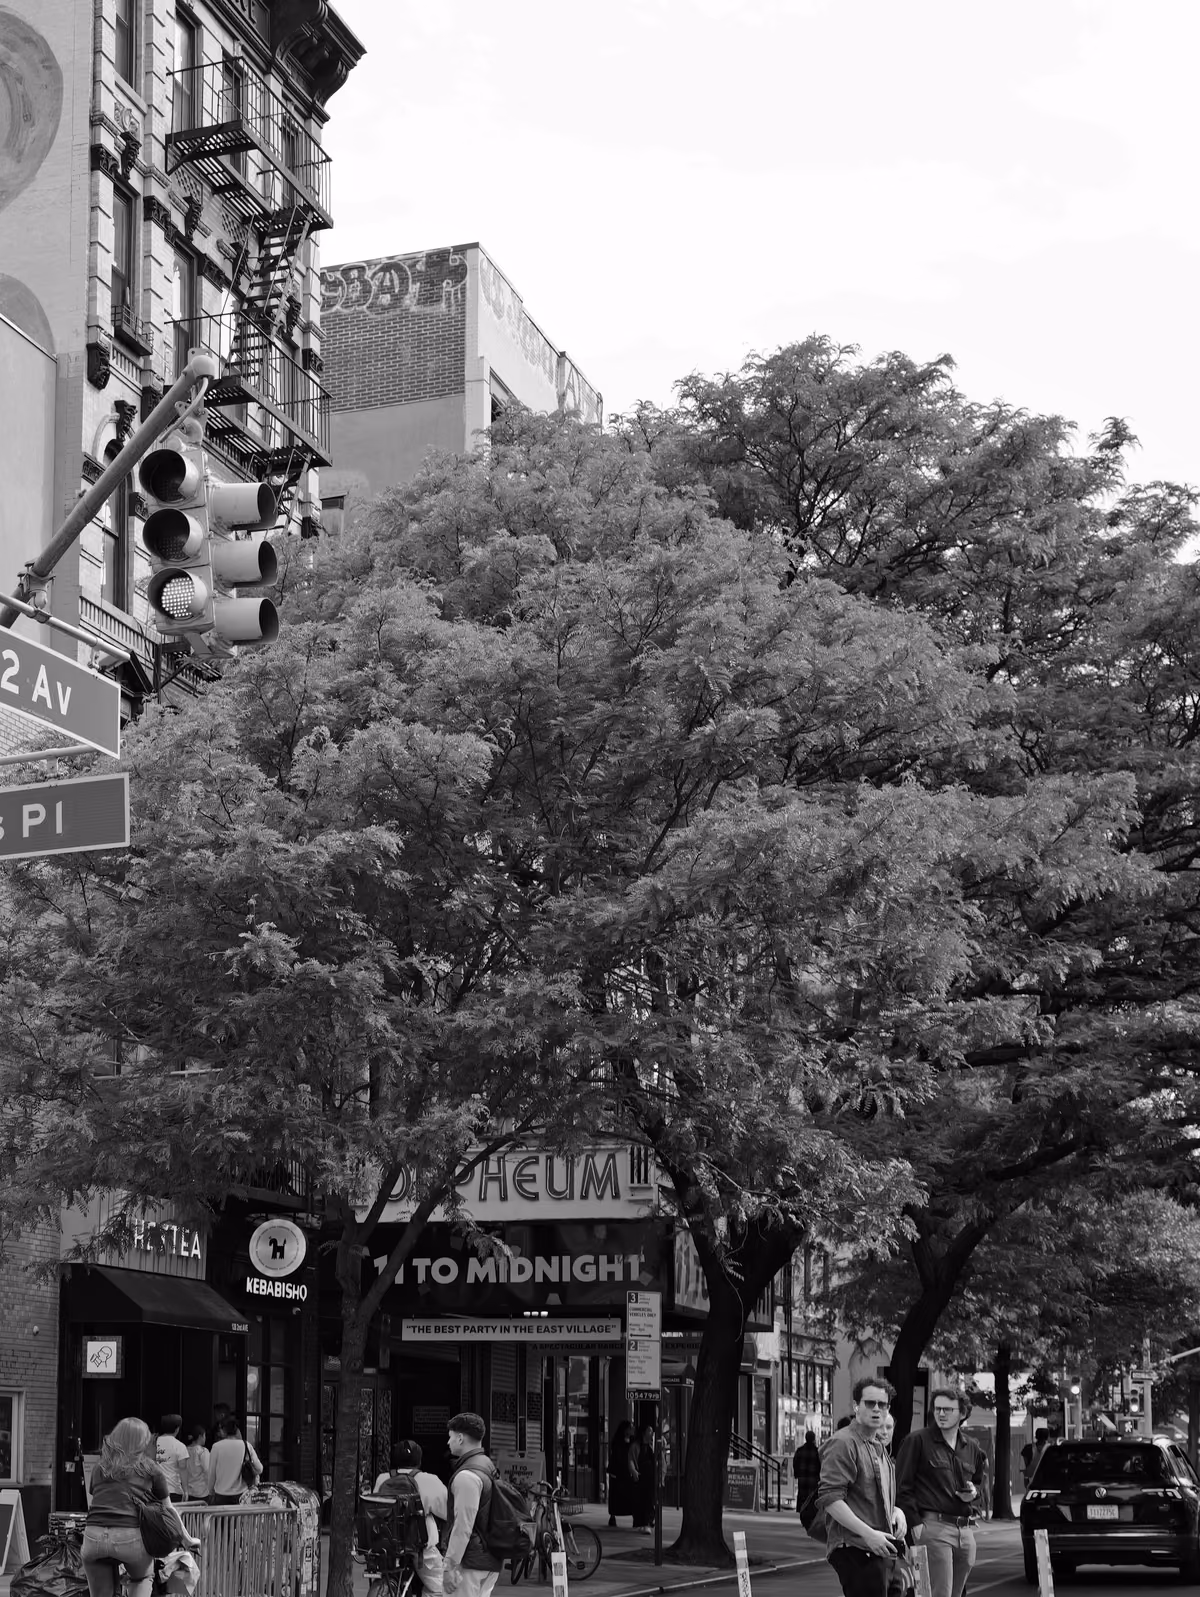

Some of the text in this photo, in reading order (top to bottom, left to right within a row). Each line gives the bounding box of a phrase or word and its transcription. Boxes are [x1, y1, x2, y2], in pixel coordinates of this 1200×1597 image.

[0, 648, 20, 694] 2
[31, 664, 72, 716] Av
[22, 801, 64, 839] Pl
[379, 1153, 621, 1202] OHEUM
[412, 1257, 459, 1285] TO
[466, 1253, 646, 1284] MIDNIGHT
[630, 1293, 636, 1303] 3
[433, 1325, 462, 1334] BEST
[463, 1325, 498, 1334] PARTY
[500, 1325, 511, 1334] IN
[512, 1324, 535, 1334] THE
[536, 1324, 564, 1334] EAST
[630, 1341, 636, 1350] 2
